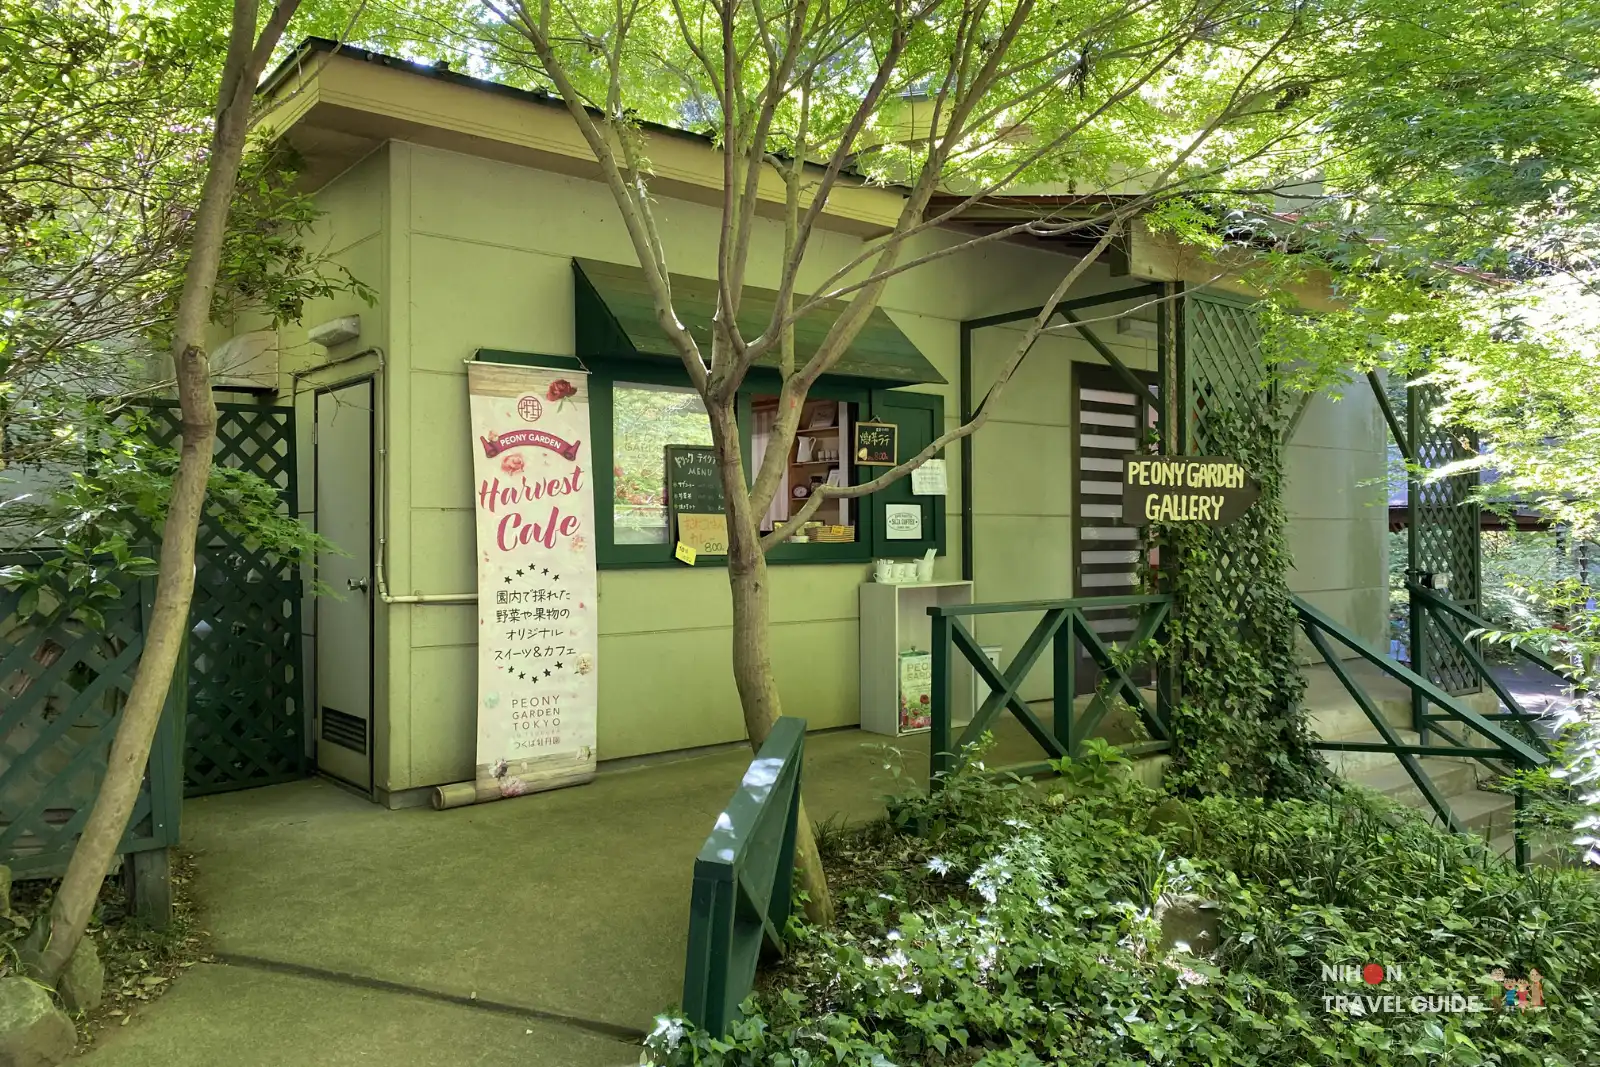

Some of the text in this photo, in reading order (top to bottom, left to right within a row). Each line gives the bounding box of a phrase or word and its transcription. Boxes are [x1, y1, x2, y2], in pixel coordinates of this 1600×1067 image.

[500, 433, 562, 450] PEONY GARDEN
[687, 467, 713, 477] MENU
[1127, 461, 1245, 489] PEONY GARDEN
[478, 465, 585, 513] Harvest
[1145, 493, 1225, 522] GALLERY
[496, 505, 581, 551] Cafe
[496, 588, 571, 605] 園内で採れた
[496, 607, 571, 623] 野菜や果物の
[506, 627, 564, 641] オリジナル
[511, 694, 560, 709] PEONY
[512, 707, 560, 720] GARDEN
[513, 717, 561, 731] TOKYO
